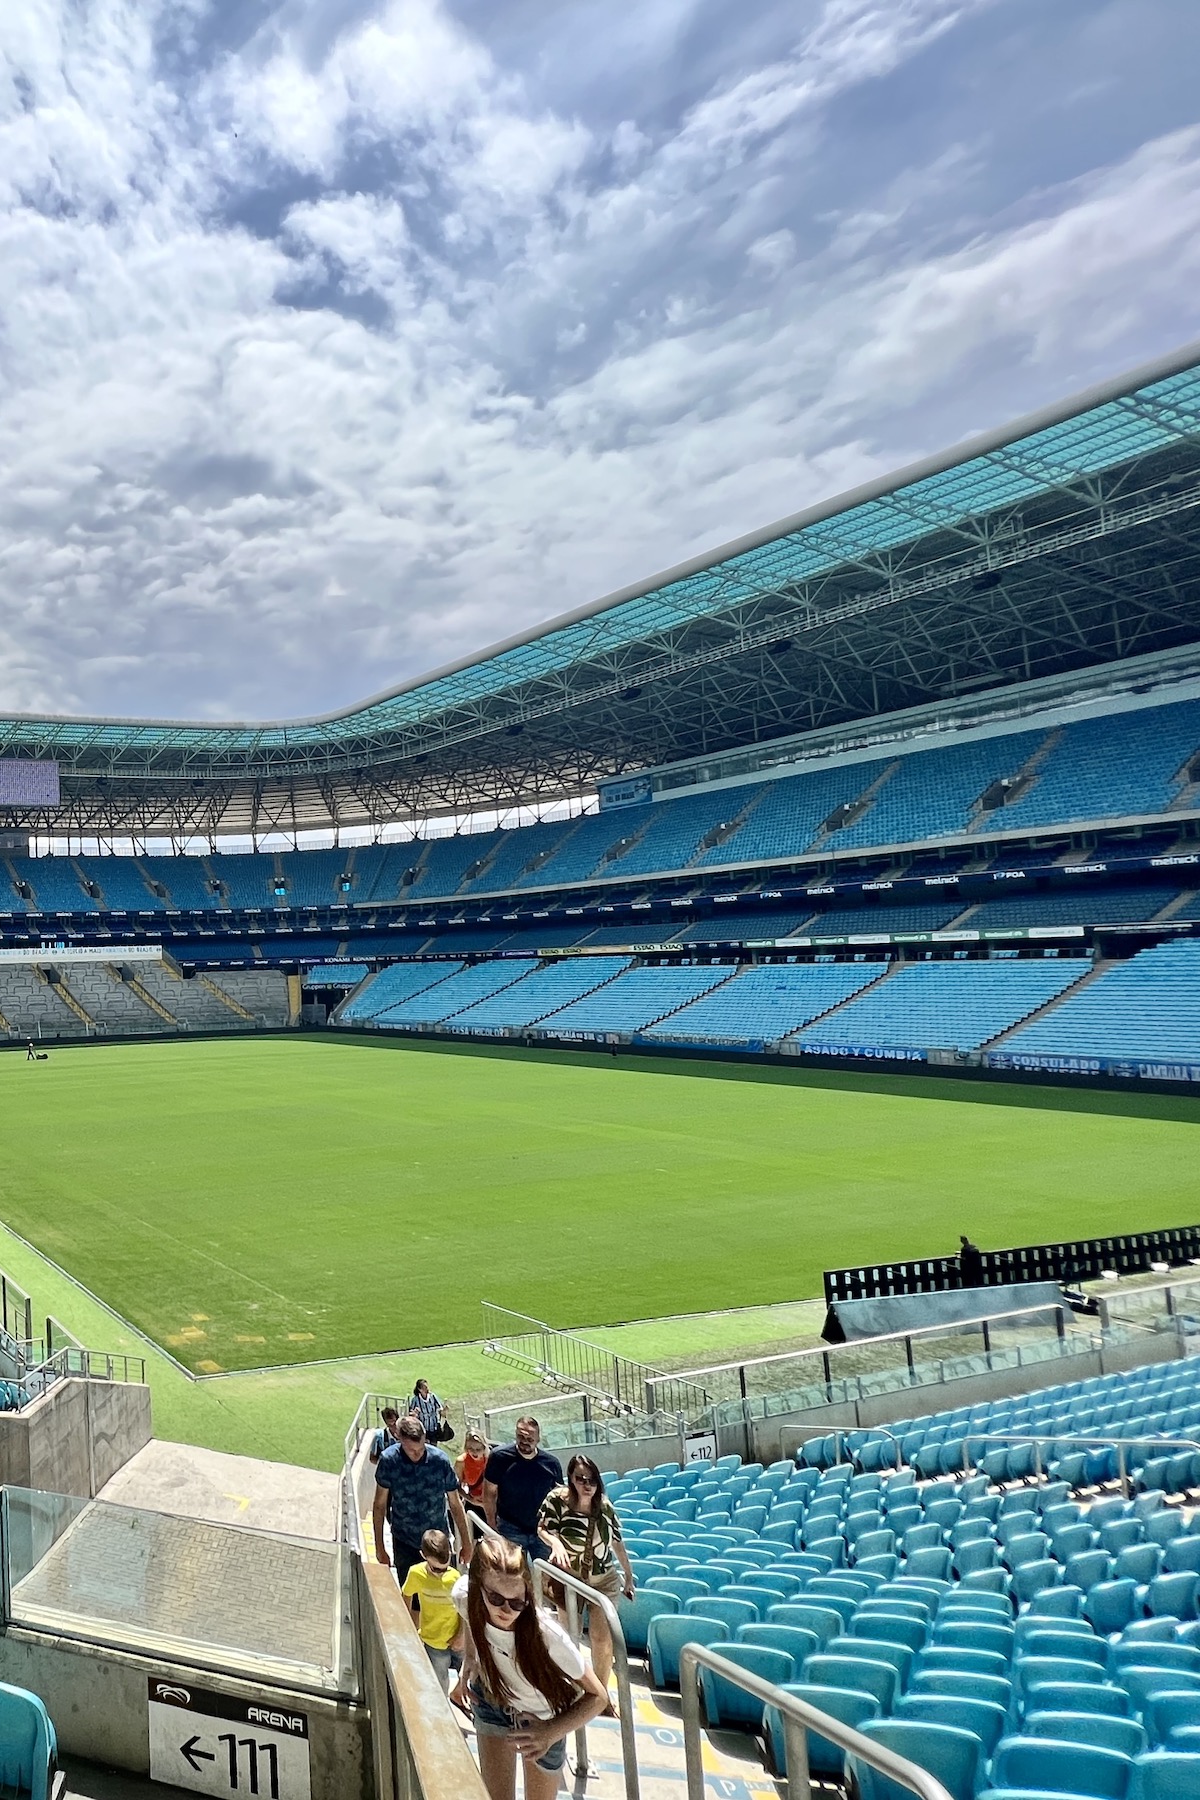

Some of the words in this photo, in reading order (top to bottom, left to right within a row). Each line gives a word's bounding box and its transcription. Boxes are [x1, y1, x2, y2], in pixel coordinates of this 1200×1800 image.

[1151, 854, 1200, 867] melnick
[1064, 863, 1108, 874] melnick
[861, 881, 894, 890] melnick
[924, 875, 960, 886] melnick
[804, 1044, 849, 1057] ASADO
[853, 1047, 861, 1057] Y
[864, 1048, 923, 1061] CUMBIA
[1012, 1055, 1100, 1070] CONSULADO
[698, 1445, 713, 1460] 112
[247, 1706, 304, 1733] ARENA
[217, 1733, 279, 1800] 111
